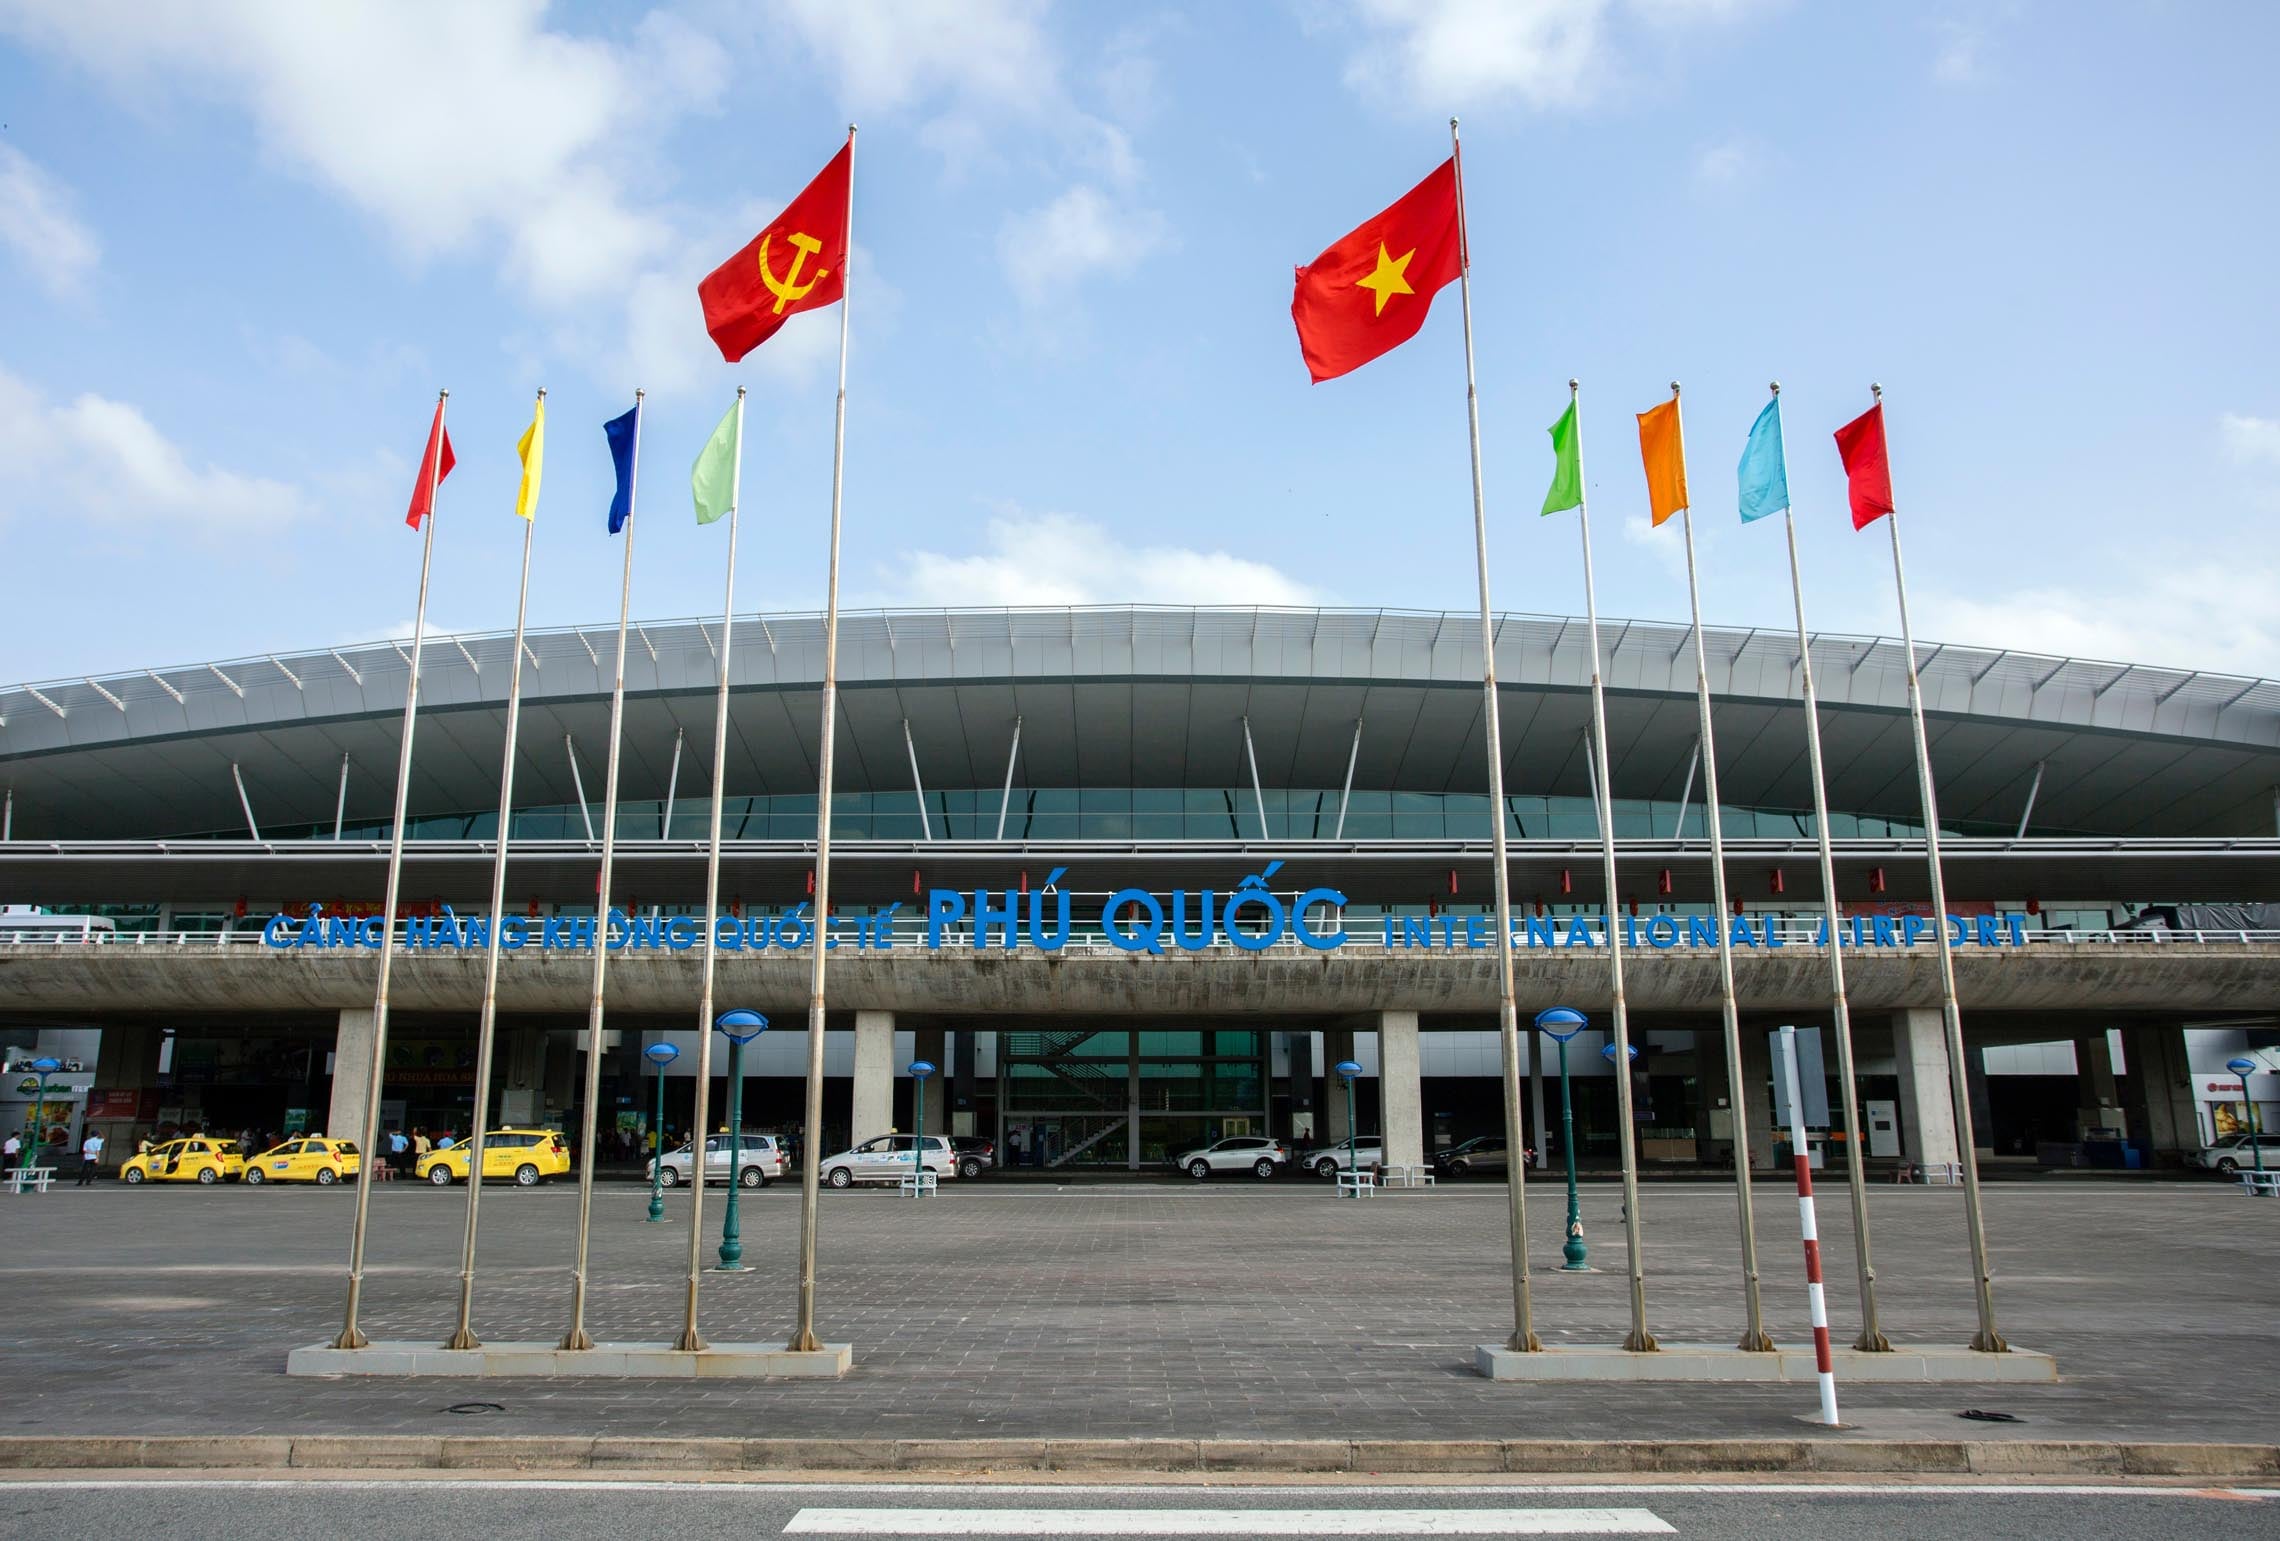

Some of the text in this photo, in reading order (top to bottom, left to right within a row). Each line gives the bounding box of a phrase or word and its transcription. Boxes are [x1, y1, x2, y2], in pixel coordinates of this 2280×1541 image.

[264, 860, 2026, 955] CẢNG HÀNG KHÔNG QUỐC TẾ PHÚ QUỐC INTENAIONAL AIRPORT
